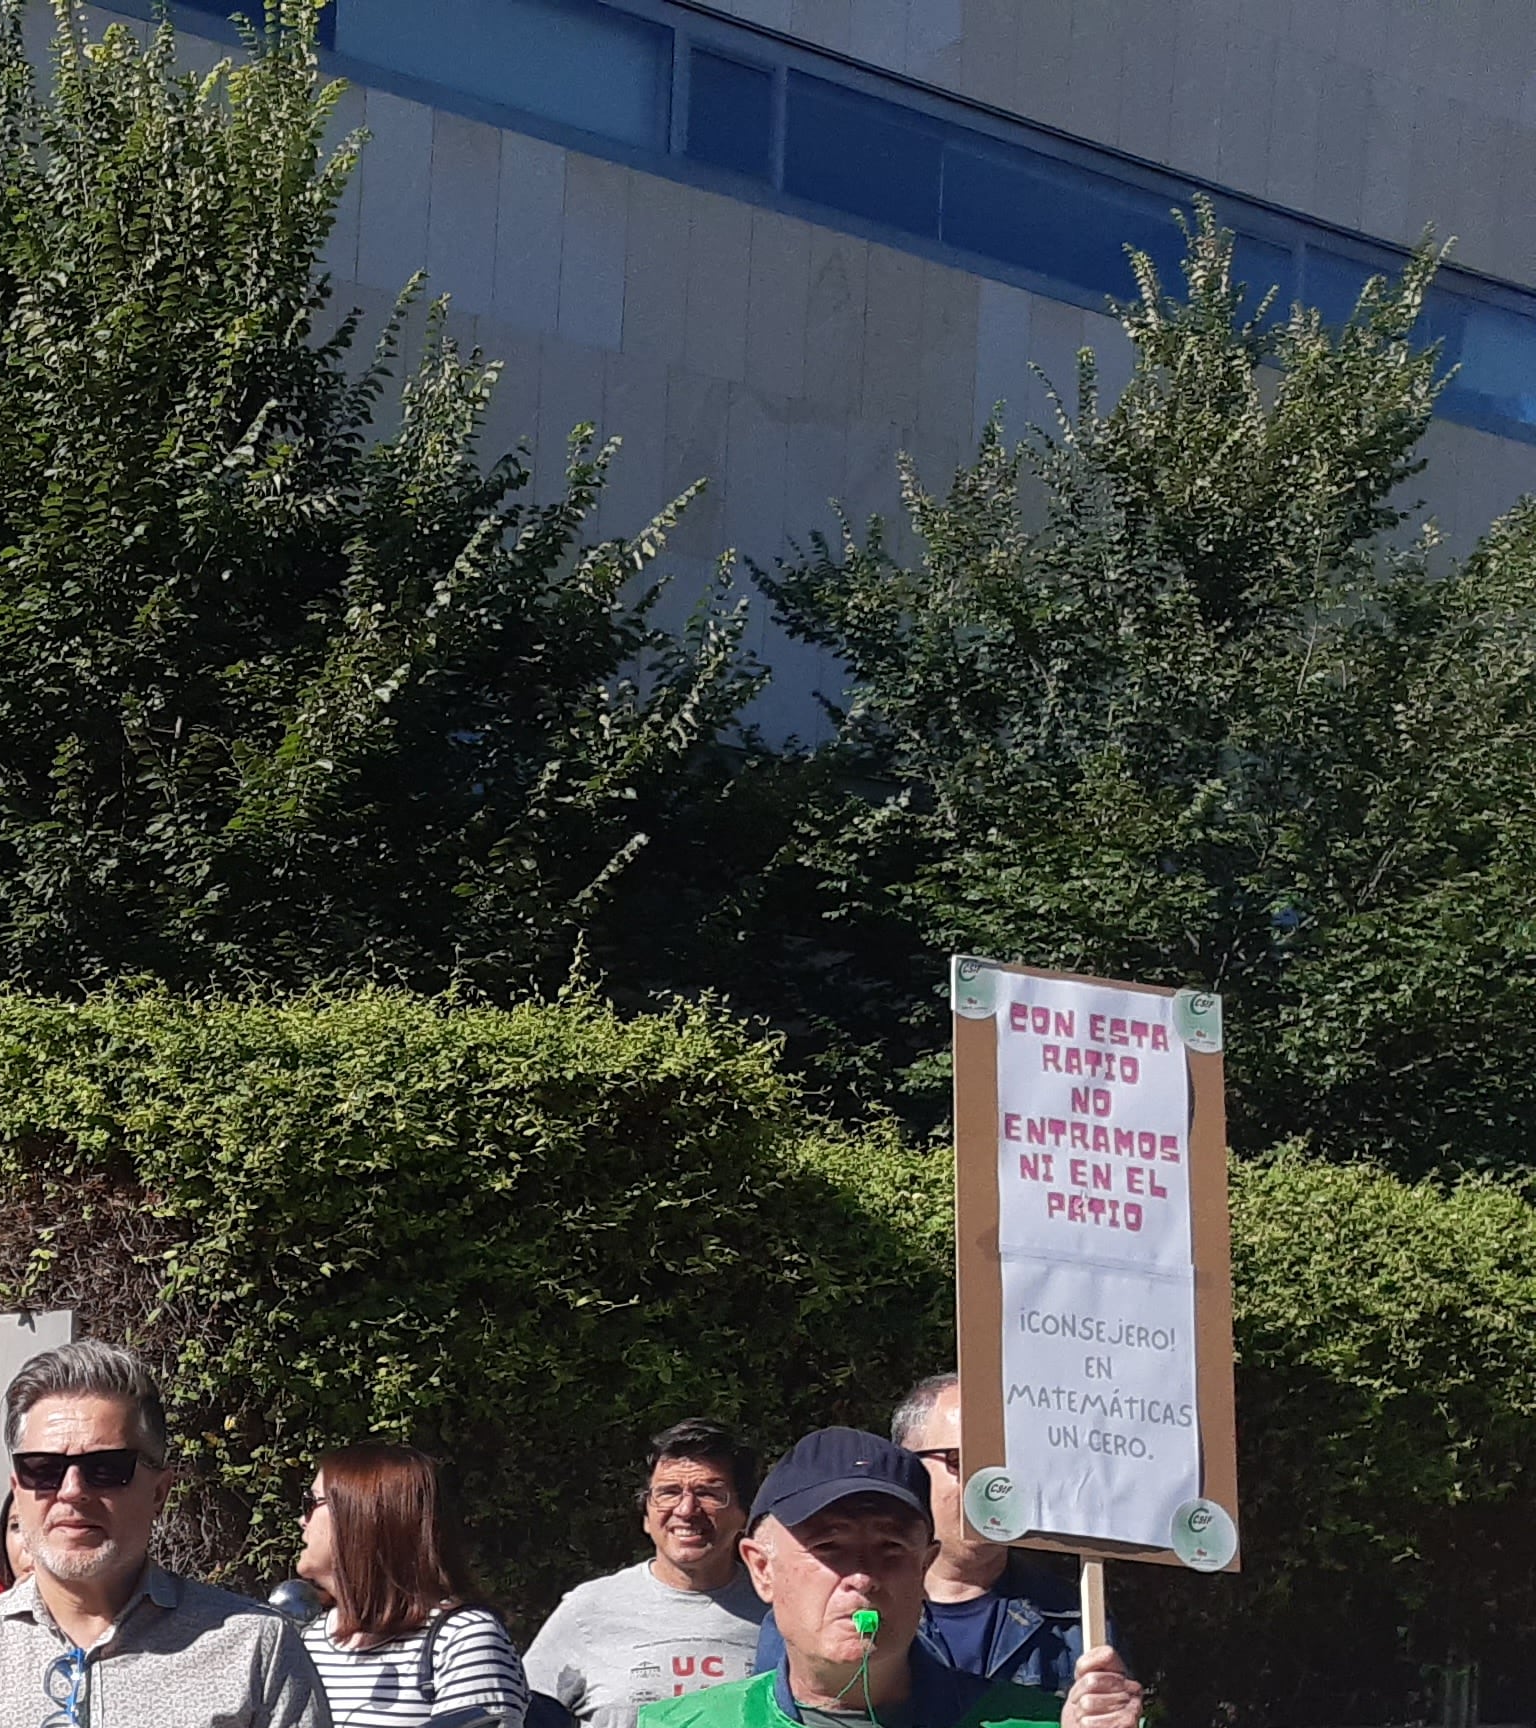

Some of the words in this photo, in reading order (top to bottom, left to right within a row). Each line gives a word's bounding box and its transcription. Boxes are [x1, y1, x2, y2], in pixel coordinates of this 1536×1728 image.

[1009, 1002, 1075, 1038] CON
[1089, 1014, 1170, 1051] ESTA
[1042, 1044, 1140, 1085] RATIO
[1071, 1086, 1112, 1118] NO
[1004, 1112, 1180, 1163] ENTRAMOS
[1020, 1154, 1053, 1183] NI
[1070, 1158, 1112, 1191] EN
[1126, 1166, 1168, 1199] EL
[1047, 1192, 1143, 1232] PATIO
[1020, 1307, 1176, 1351] ¡CONSEJERO!
[1085, 1356, 1112, 1380] EN
[1007, 1384, 1193, 1427] MATEMÁTICAS
[1048, 1425, 1078, 1449] UN
[1088, 1429, 1154, 1460] CERO.
